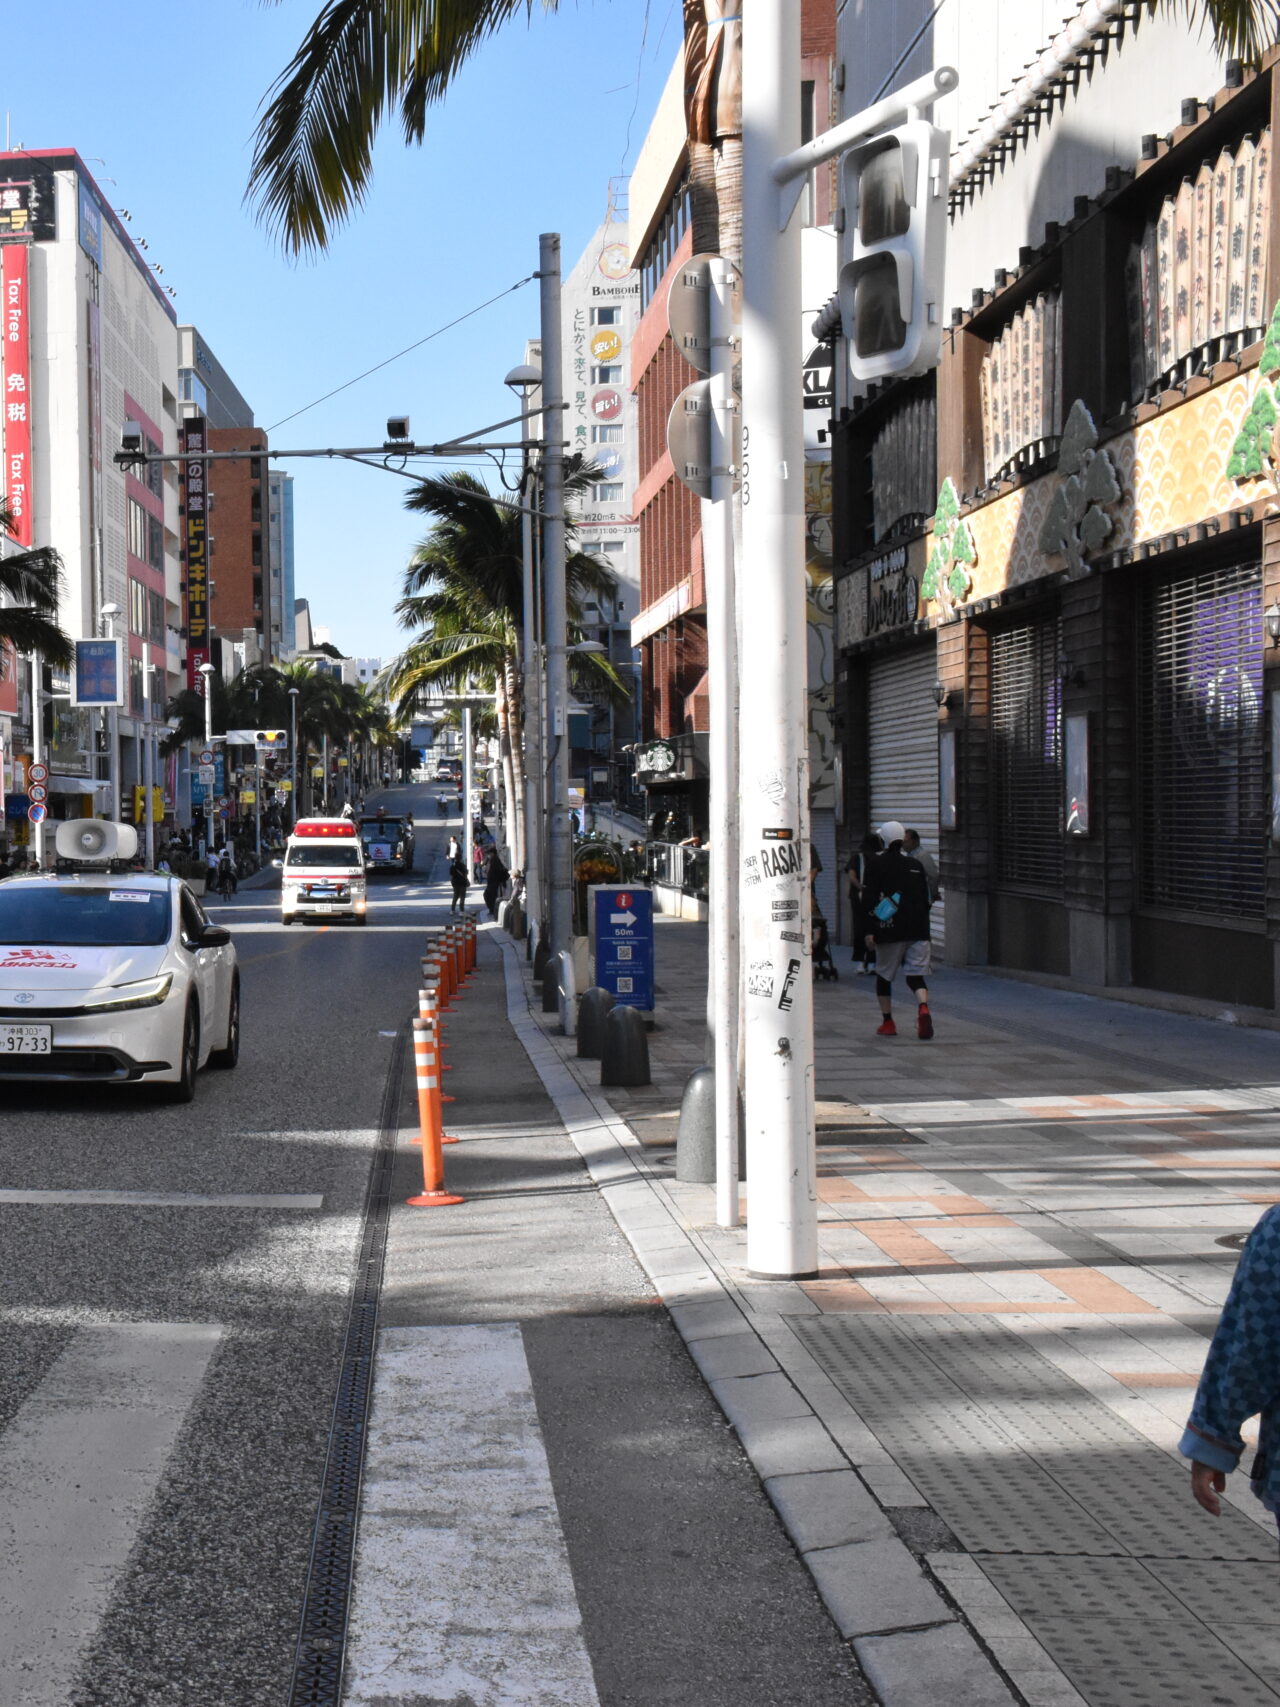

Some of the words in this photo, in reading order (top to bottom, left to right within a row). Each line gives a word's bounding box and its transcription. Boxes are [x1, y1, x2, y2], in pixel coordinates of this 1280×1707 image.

[8, 277, 21, 305] Tax
[9, 308, 22, 342] Free
[7, 373, 26, 422] 免税
[11, 452, 24, 480] Tax
[12, 483, 25, 517] Free
[192, 653, 203, 673] Tax
[614, 928, 634, 936] 50m
[7, 1036, 48, 1052] 97-33
[8, 1027, 24, 1036] 沖縄
[25, 1027, 39, 1036] 303
